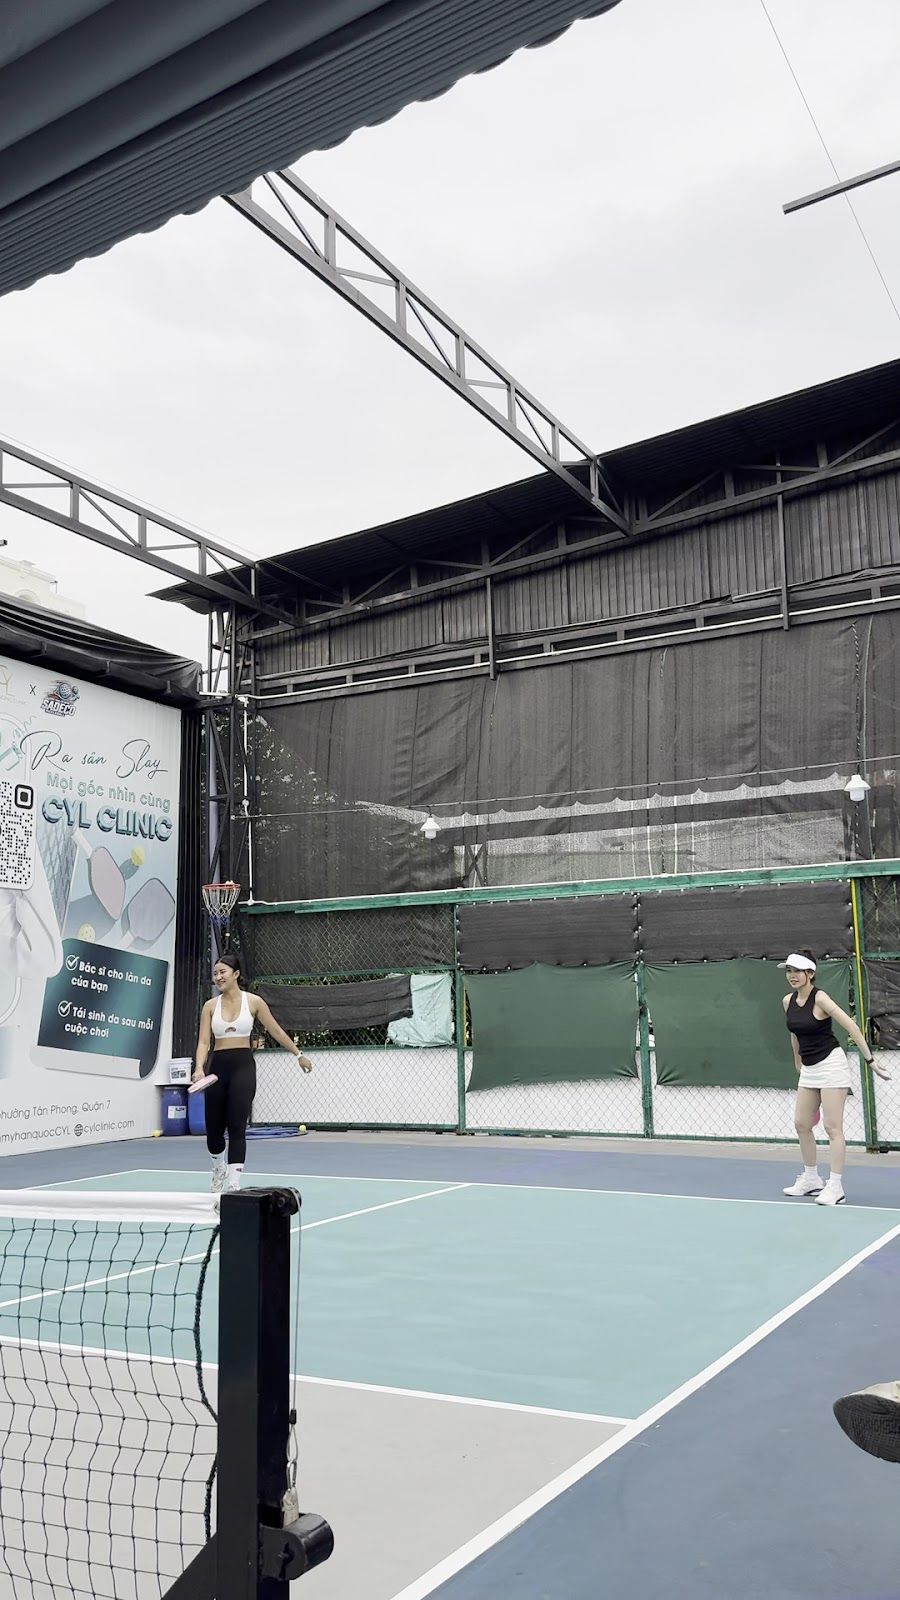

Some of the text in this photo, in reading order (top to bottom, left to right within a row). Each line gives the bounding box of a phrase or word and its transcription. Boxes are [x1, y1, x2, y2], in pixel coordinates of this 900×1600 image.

[41, 699, 77, 716] SADECO
[20, 730, 169, 780] Ra sân Slay
[46, 771, 171, 814] Mọi góc nhìn cùng
[41, 794, 173, 842] CYL CLINIC
[71, 975, 109, 993] của bạn
[78, 961, 152, 986] Bác sĩ cho làn da
[72, 1006, 87, 1019] Tái
[87, 1010, 106, 1022] sinh
[107, 1013, 120, 1025] da
[121, 1017, 137, 1027] sau
[64, 1022, 110, 1038] cuộc chơi
[106, 1099, 111, 1109] 7
[0, 1119, 135, 1144] myhanquocCYL cylclinic.com
